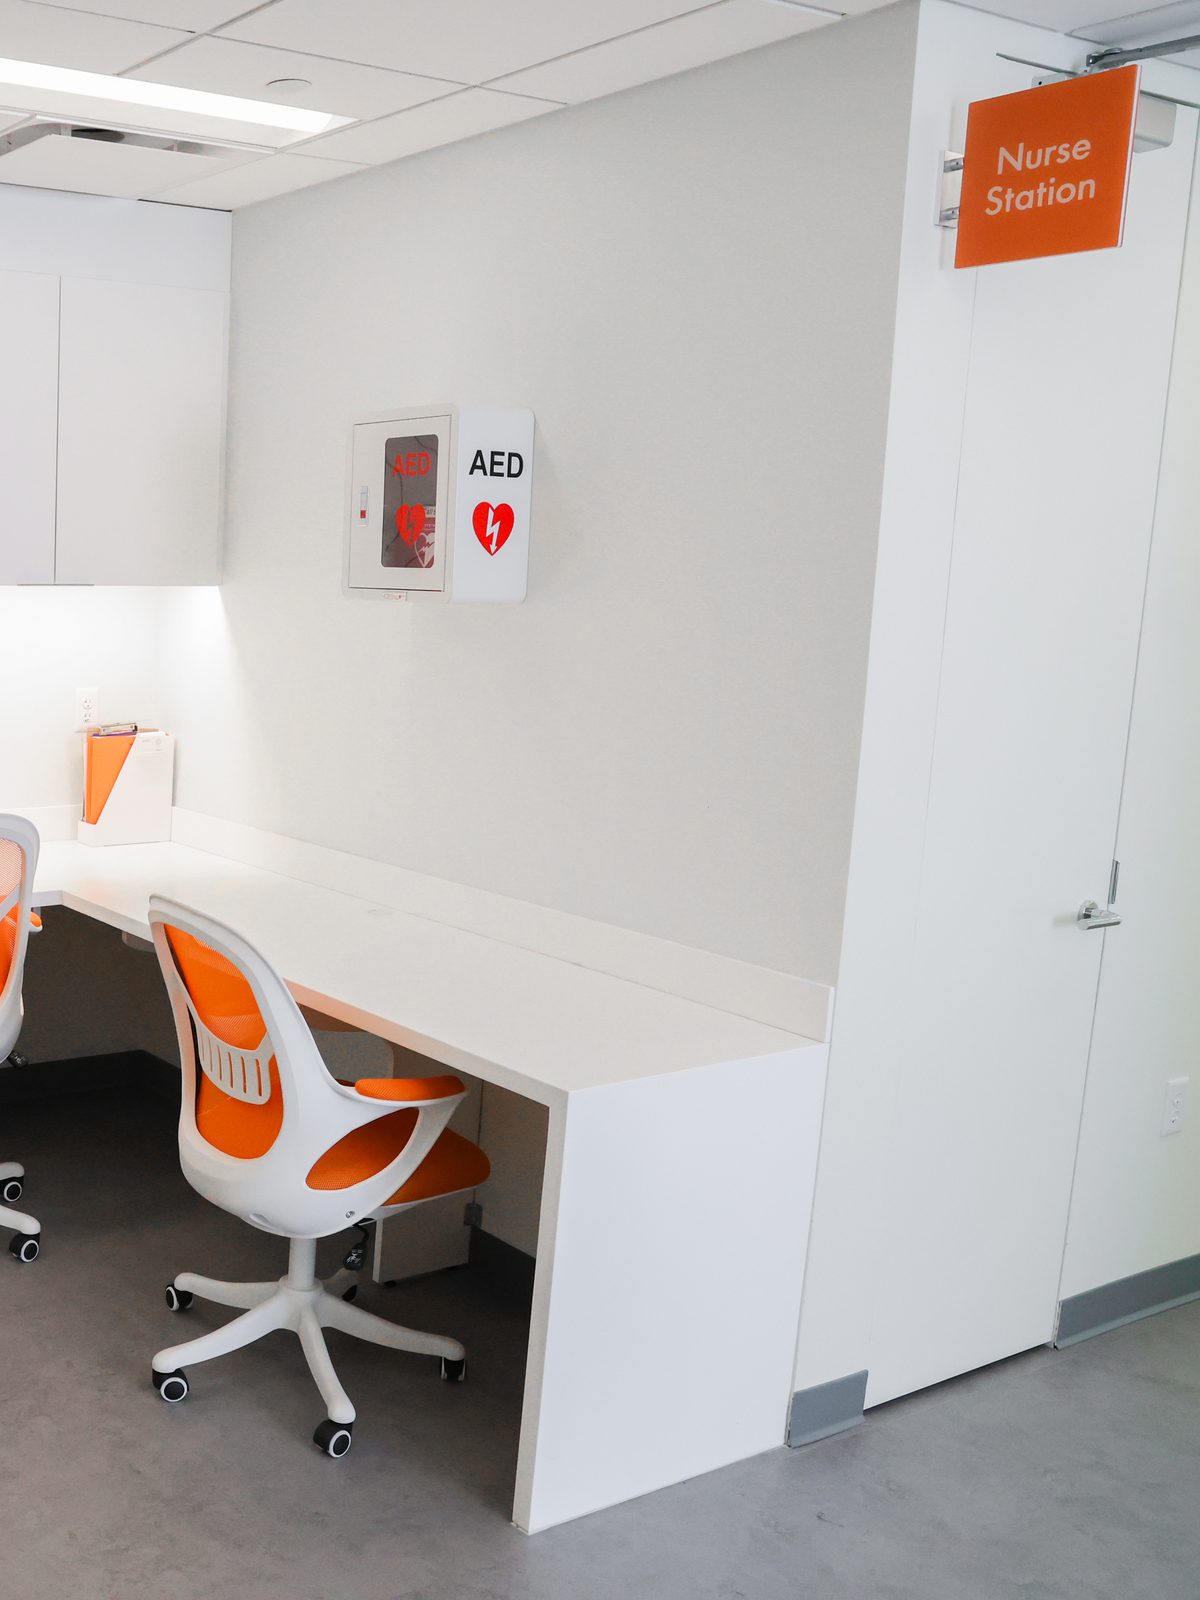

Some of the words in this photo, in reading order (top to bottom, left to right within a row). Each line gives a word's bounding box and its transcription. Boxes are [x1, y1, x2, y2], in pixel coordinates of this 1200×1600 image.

[997, 139, 1091, 175] Nurse
[985, 177, 1096, 216] Station
[391, 451, 432, 477] AED
[468, 449, 524, 478] AED
